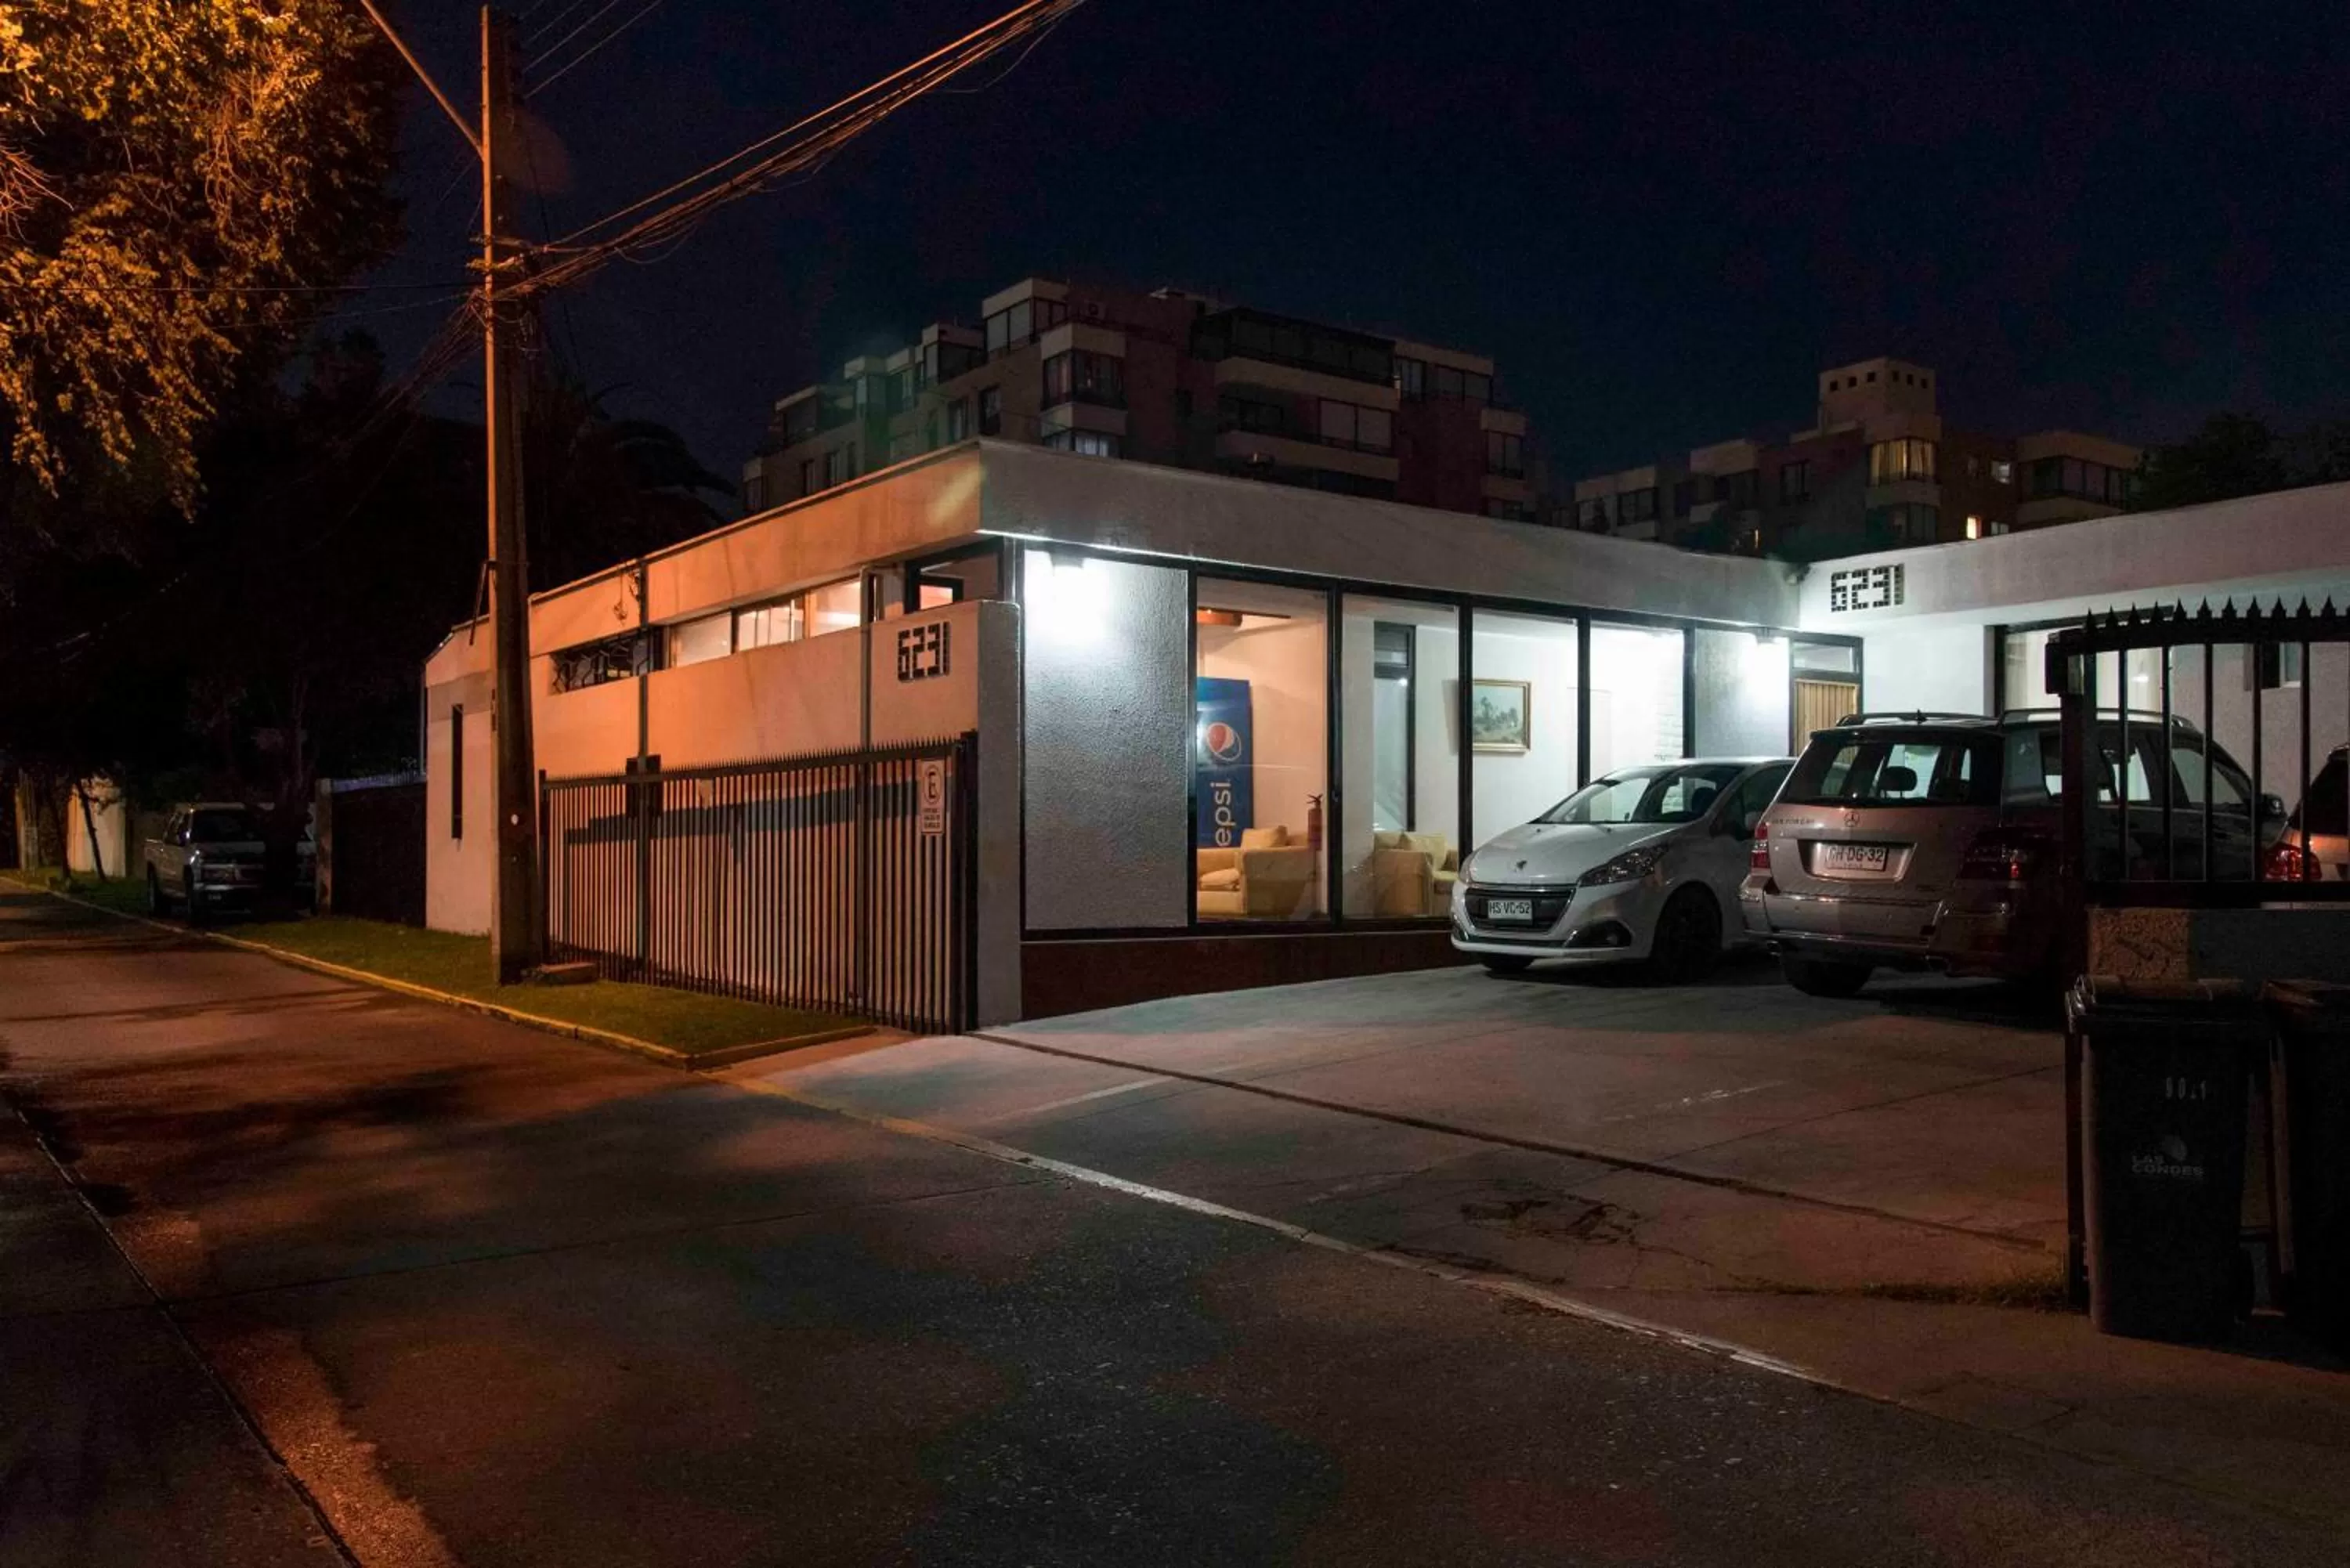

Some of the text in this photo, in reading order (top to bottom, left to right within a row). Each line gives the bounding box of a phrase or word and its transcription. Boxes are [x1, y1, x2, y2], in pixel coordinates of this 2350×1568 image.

[1831, 563, 1904, 612] 6231
[898, 622, 949, 681] 6231
[1210, 780, 1236, 847] epsi
